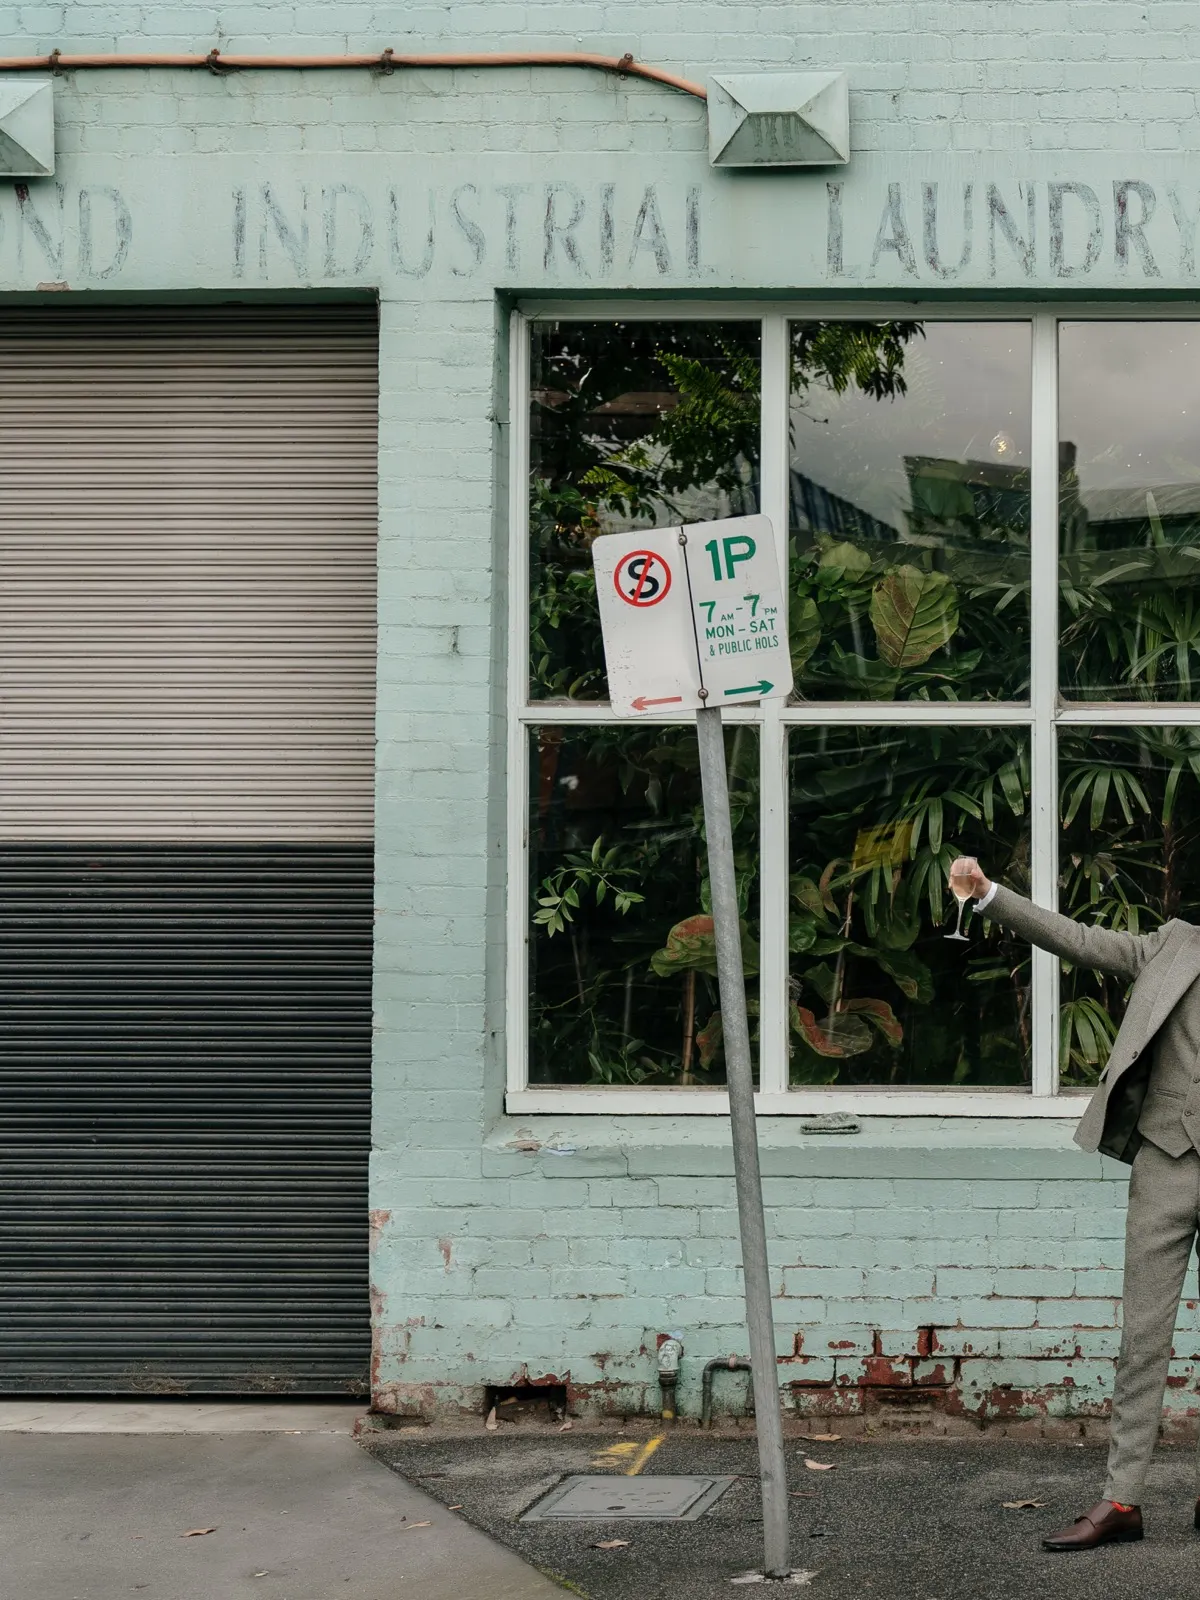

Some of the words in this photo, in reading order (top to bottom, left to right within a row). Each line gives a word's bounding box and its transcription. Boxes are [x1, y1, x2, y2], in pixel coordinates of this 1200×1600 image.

[0, 181, 132, 279] ND
[231, 182, 717, 279] INDUSTRIAL
[705, 535, 756, 581] 1P
[705, 624, 735, 640] MON
[749, 618, 775, 633] SAT
[718, 638, 752, 655] PUBLIC
[755, 635, 779, 650] HOLS
